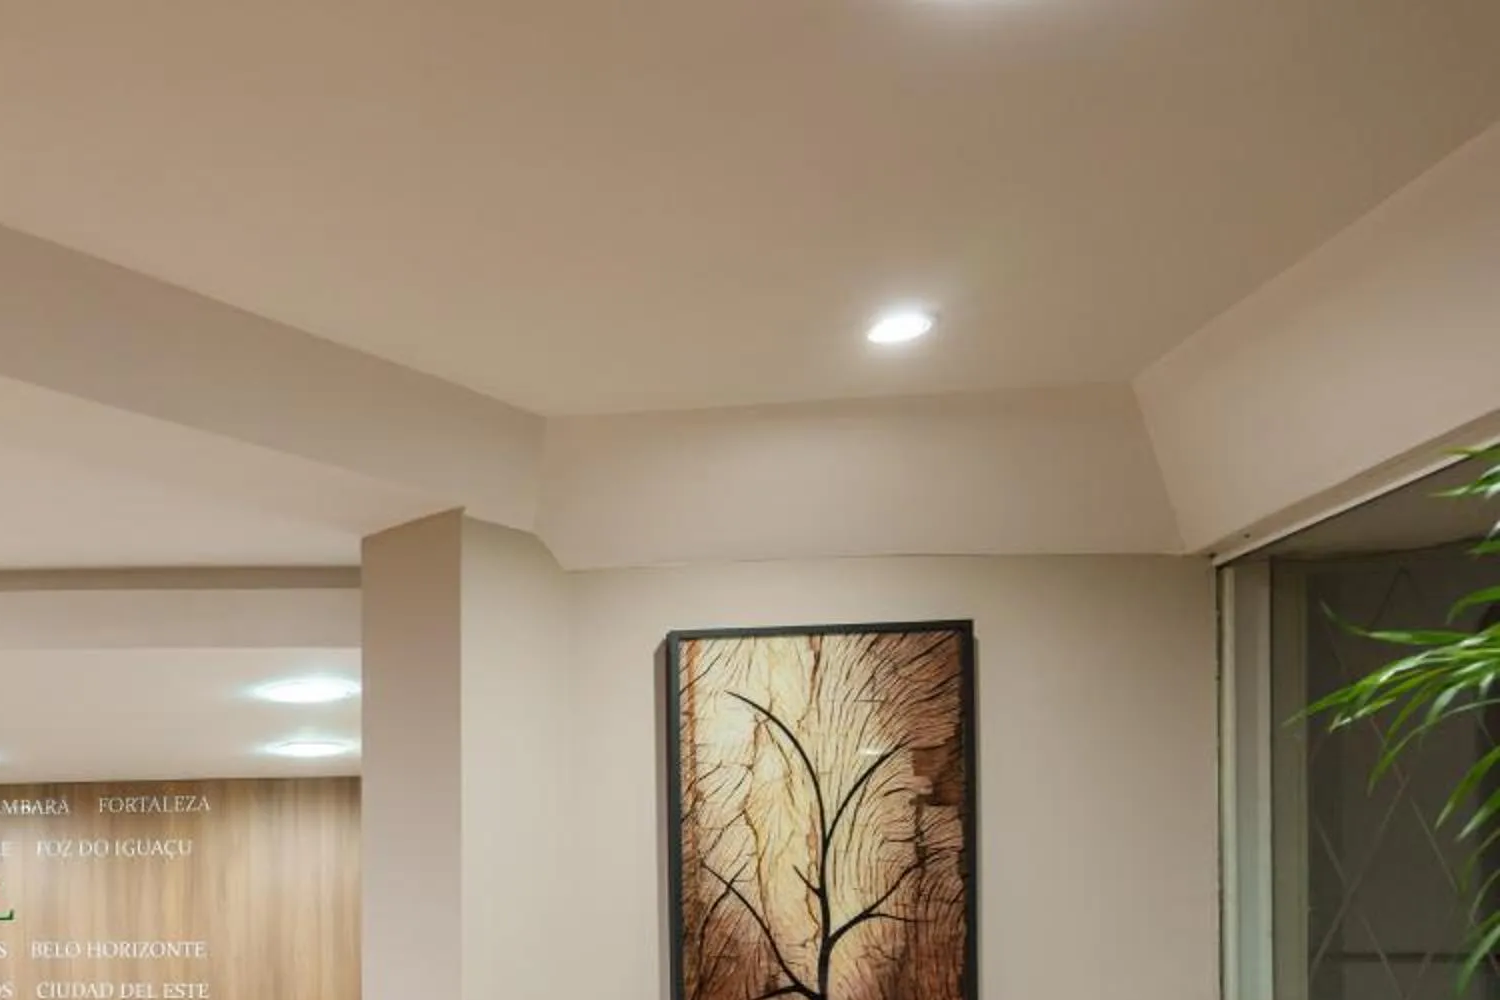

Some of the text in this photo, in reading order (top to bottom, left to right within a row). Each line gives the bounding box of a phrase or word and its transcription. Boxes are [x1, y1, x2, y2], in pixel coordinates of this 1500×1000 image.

[99, 795, 211, 814] FORTALEZA
[37, 840, 72, 857] FOZ
[79, 840, 110, 857] DO
[115, 839, 193, 860] IGUAÇU
[31, 942, 81, 959] BELO
[87, 942, 207, 958] HORIZONTE
[36, 982, 114, 999] CIUDAD
[121, 982, 155, 998] DEL
[163, 982, 210, 998] ESTE
